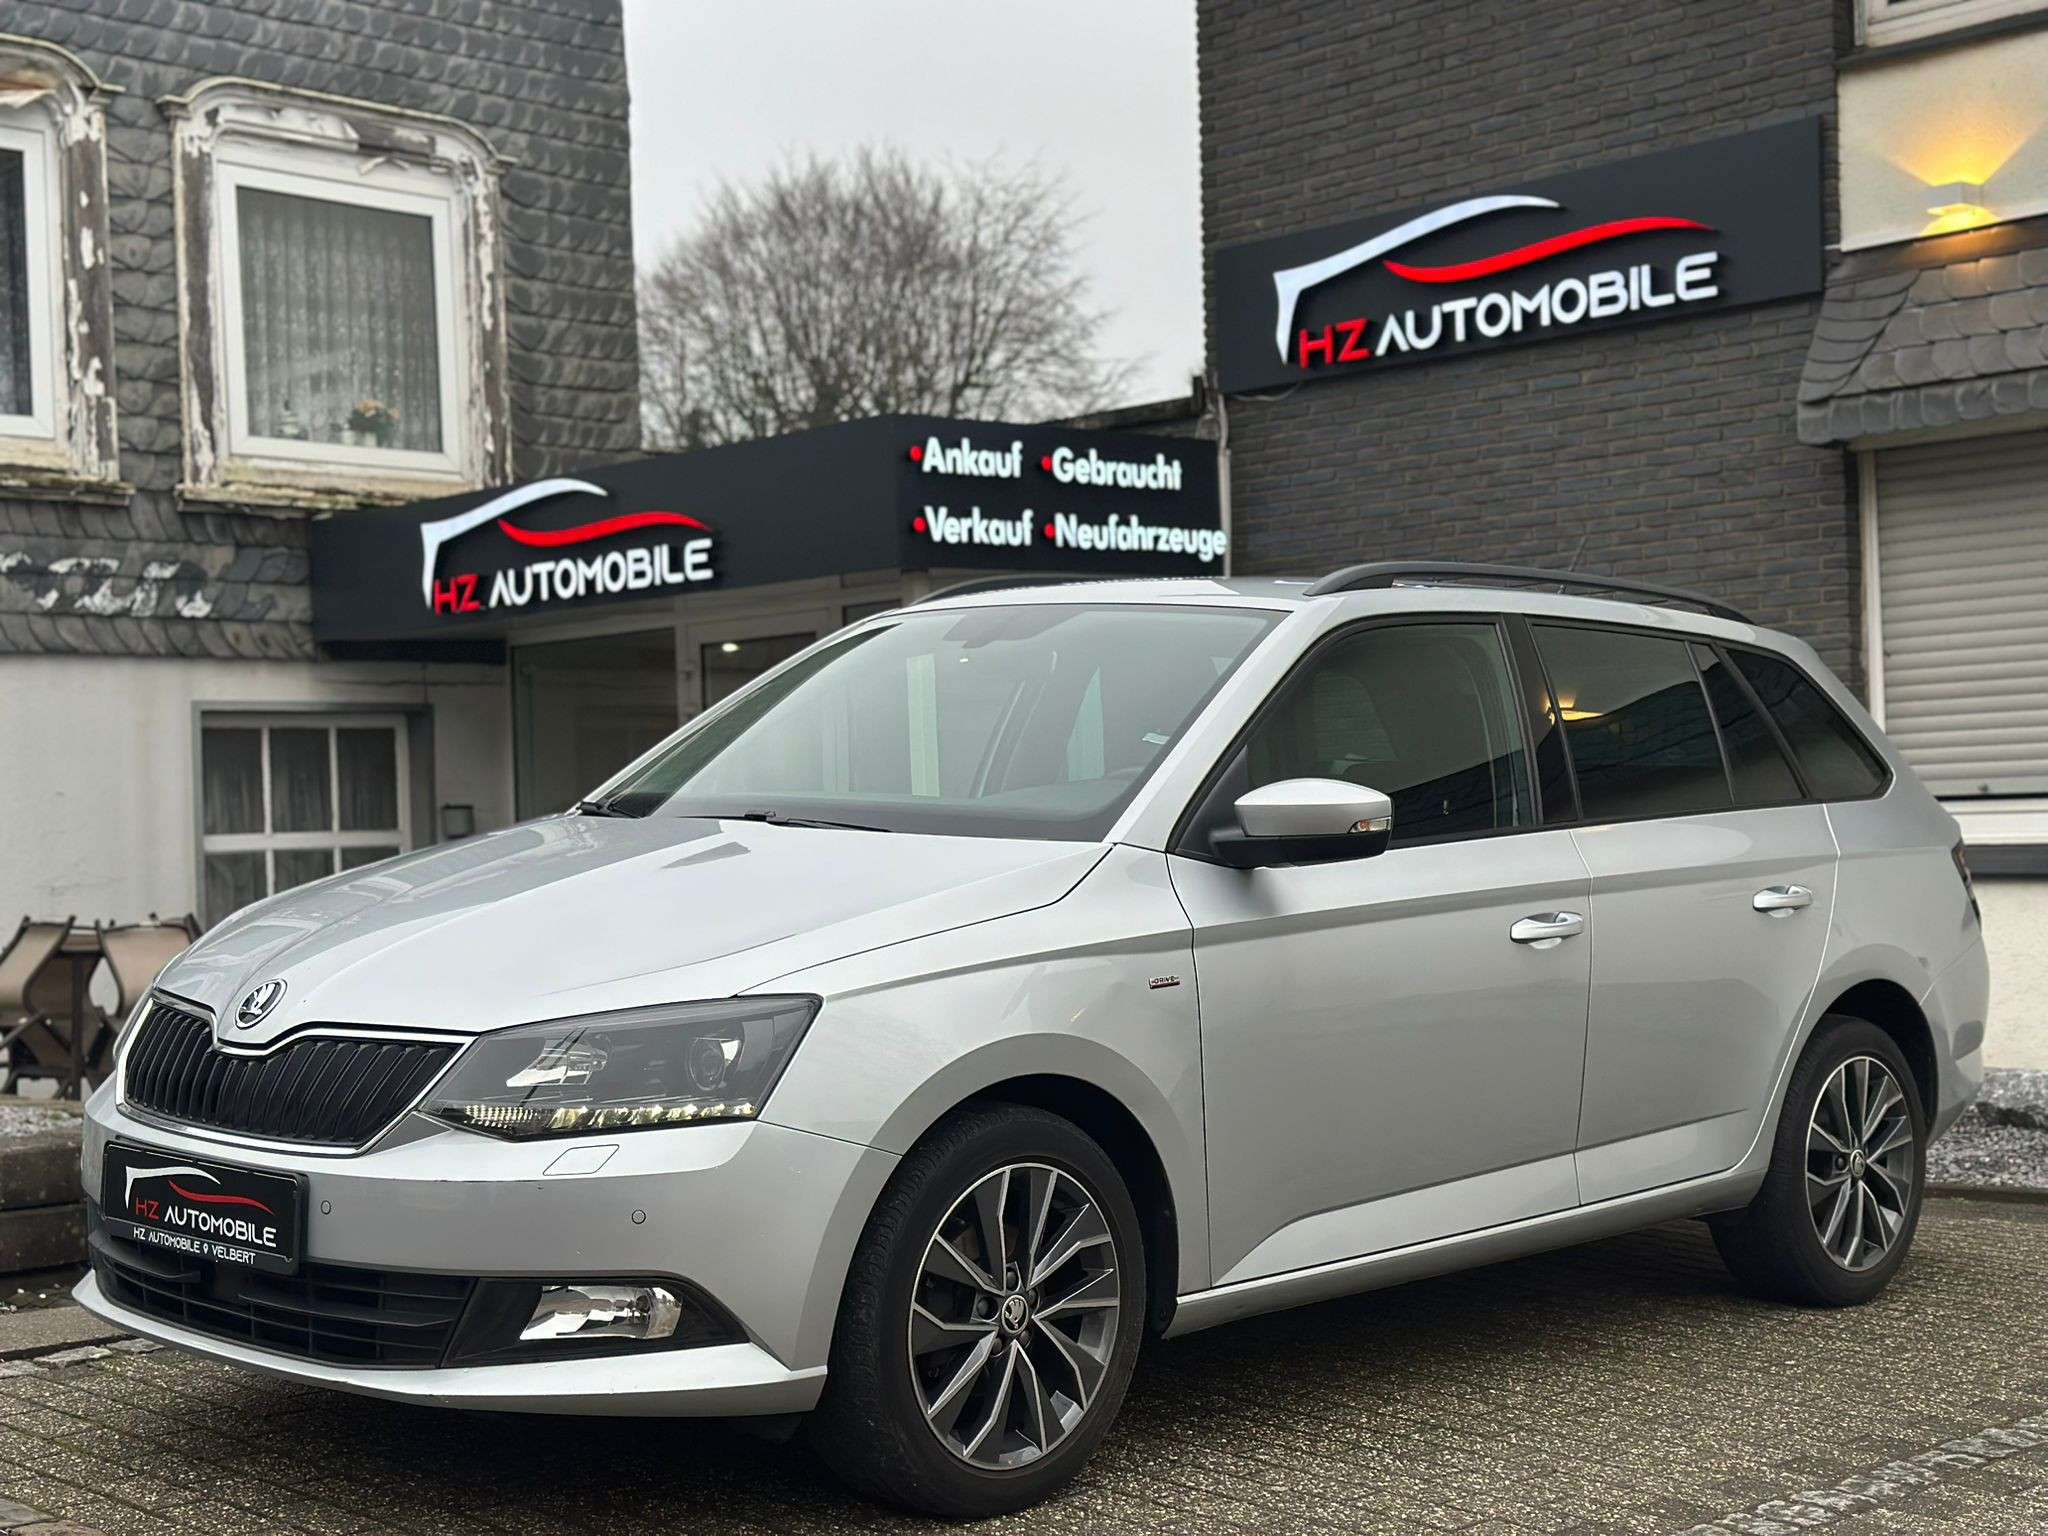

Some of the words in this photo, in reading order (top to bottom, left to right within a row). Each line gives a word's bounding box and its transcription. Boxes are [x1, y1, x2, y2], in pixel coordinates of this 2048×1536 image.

[1299, 318, 1371, 368] HZ
[1375, 251, 1719, 356] AUTOMOBILE
[922, 437, 1023, 478] Ankauf
[1052, 446, 1183, 490] Gebraucht
[924, 505, 1033, 546] Verkauf
[1054, 512, 1227, 562] Neufahrzeuge
[433, 573, 481, 617] HZ
[488, 537, 714, 609] AUTOMOBILE
[133, 1227, 146, 1240] HZ
[148, 1231, 201, 1254] AUTOMOBILE
[211, 1244, 256, 1265] VELBERT
[135, 1197, 160, 1220] HZ
[164, 1205, 277, 1247] AUTOMOBILE
